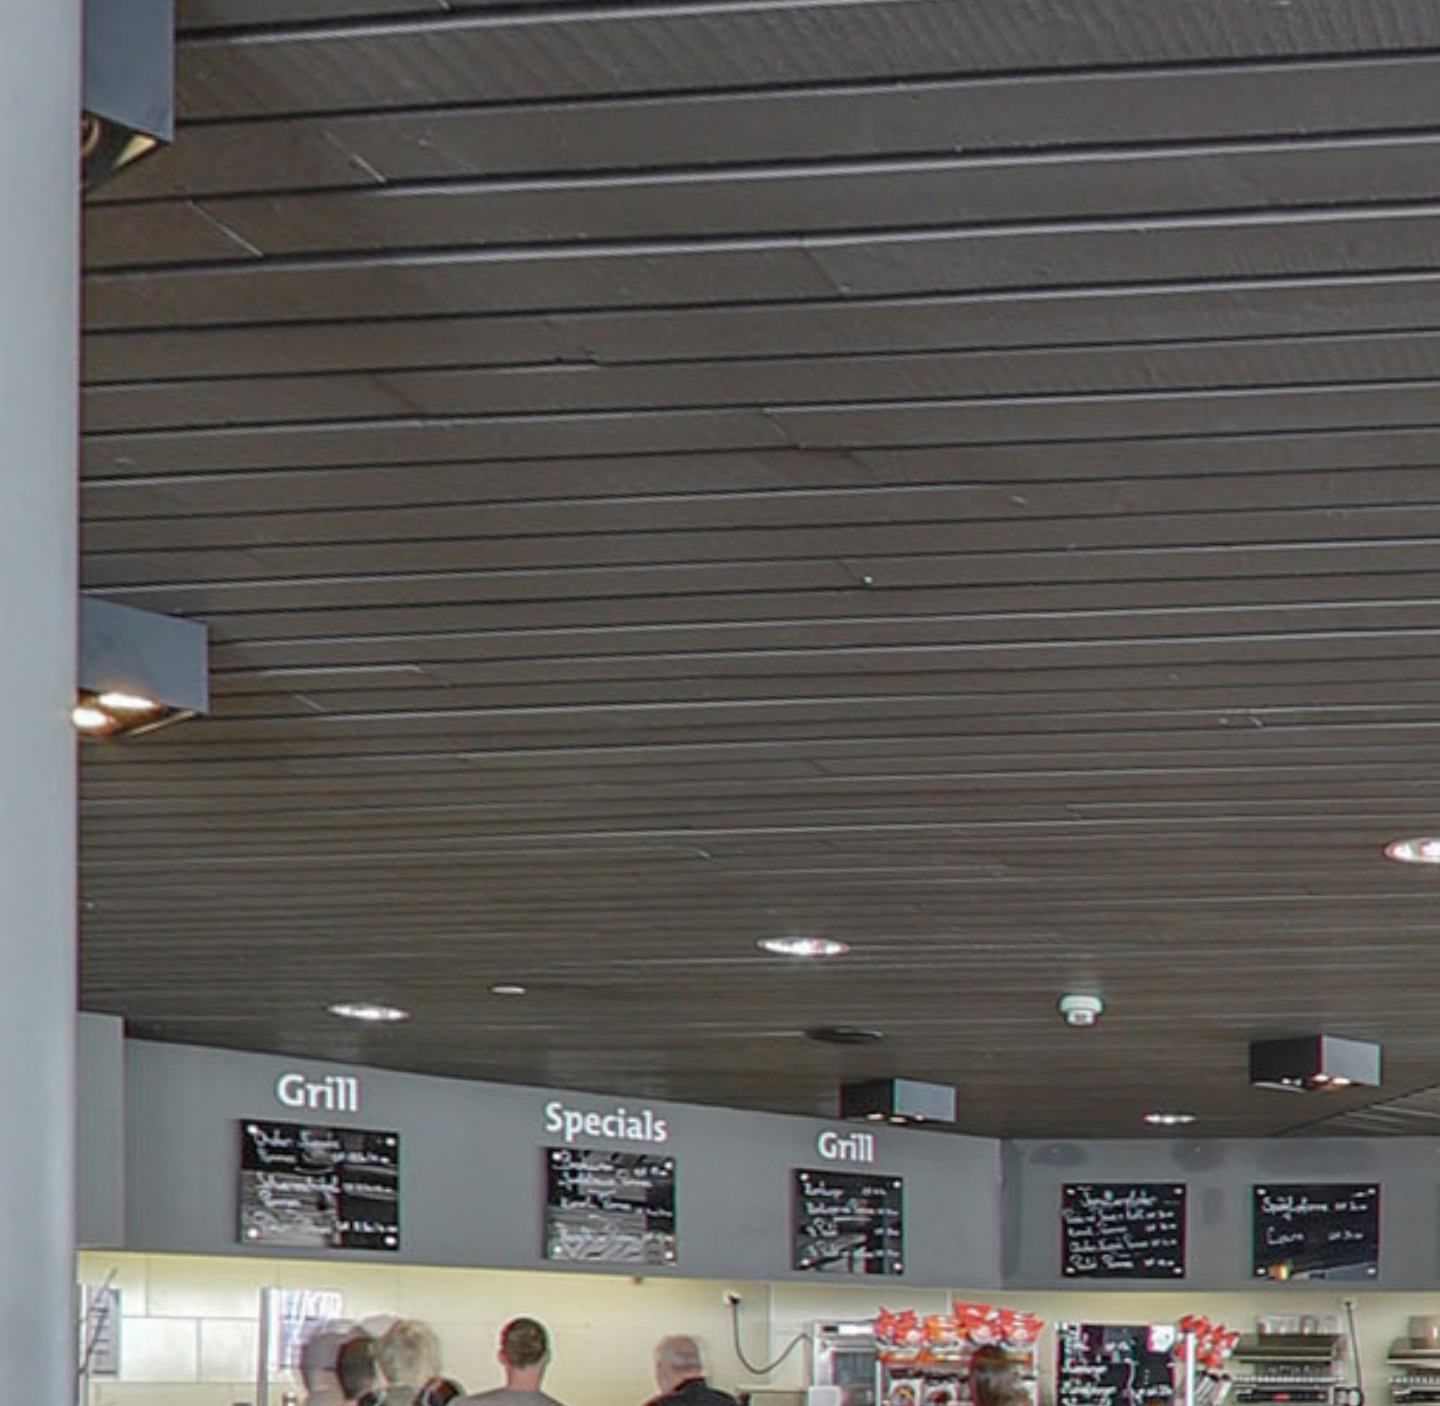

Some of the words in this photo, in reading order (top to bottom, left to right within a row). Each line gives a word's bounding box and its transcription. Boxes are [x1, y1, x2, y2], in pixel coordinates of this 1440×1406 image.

[276, 1073, 359, 1112] Grill
[544, 1101, 669, 1143] Specials
[817, 1131, 876, 1163] Grill
